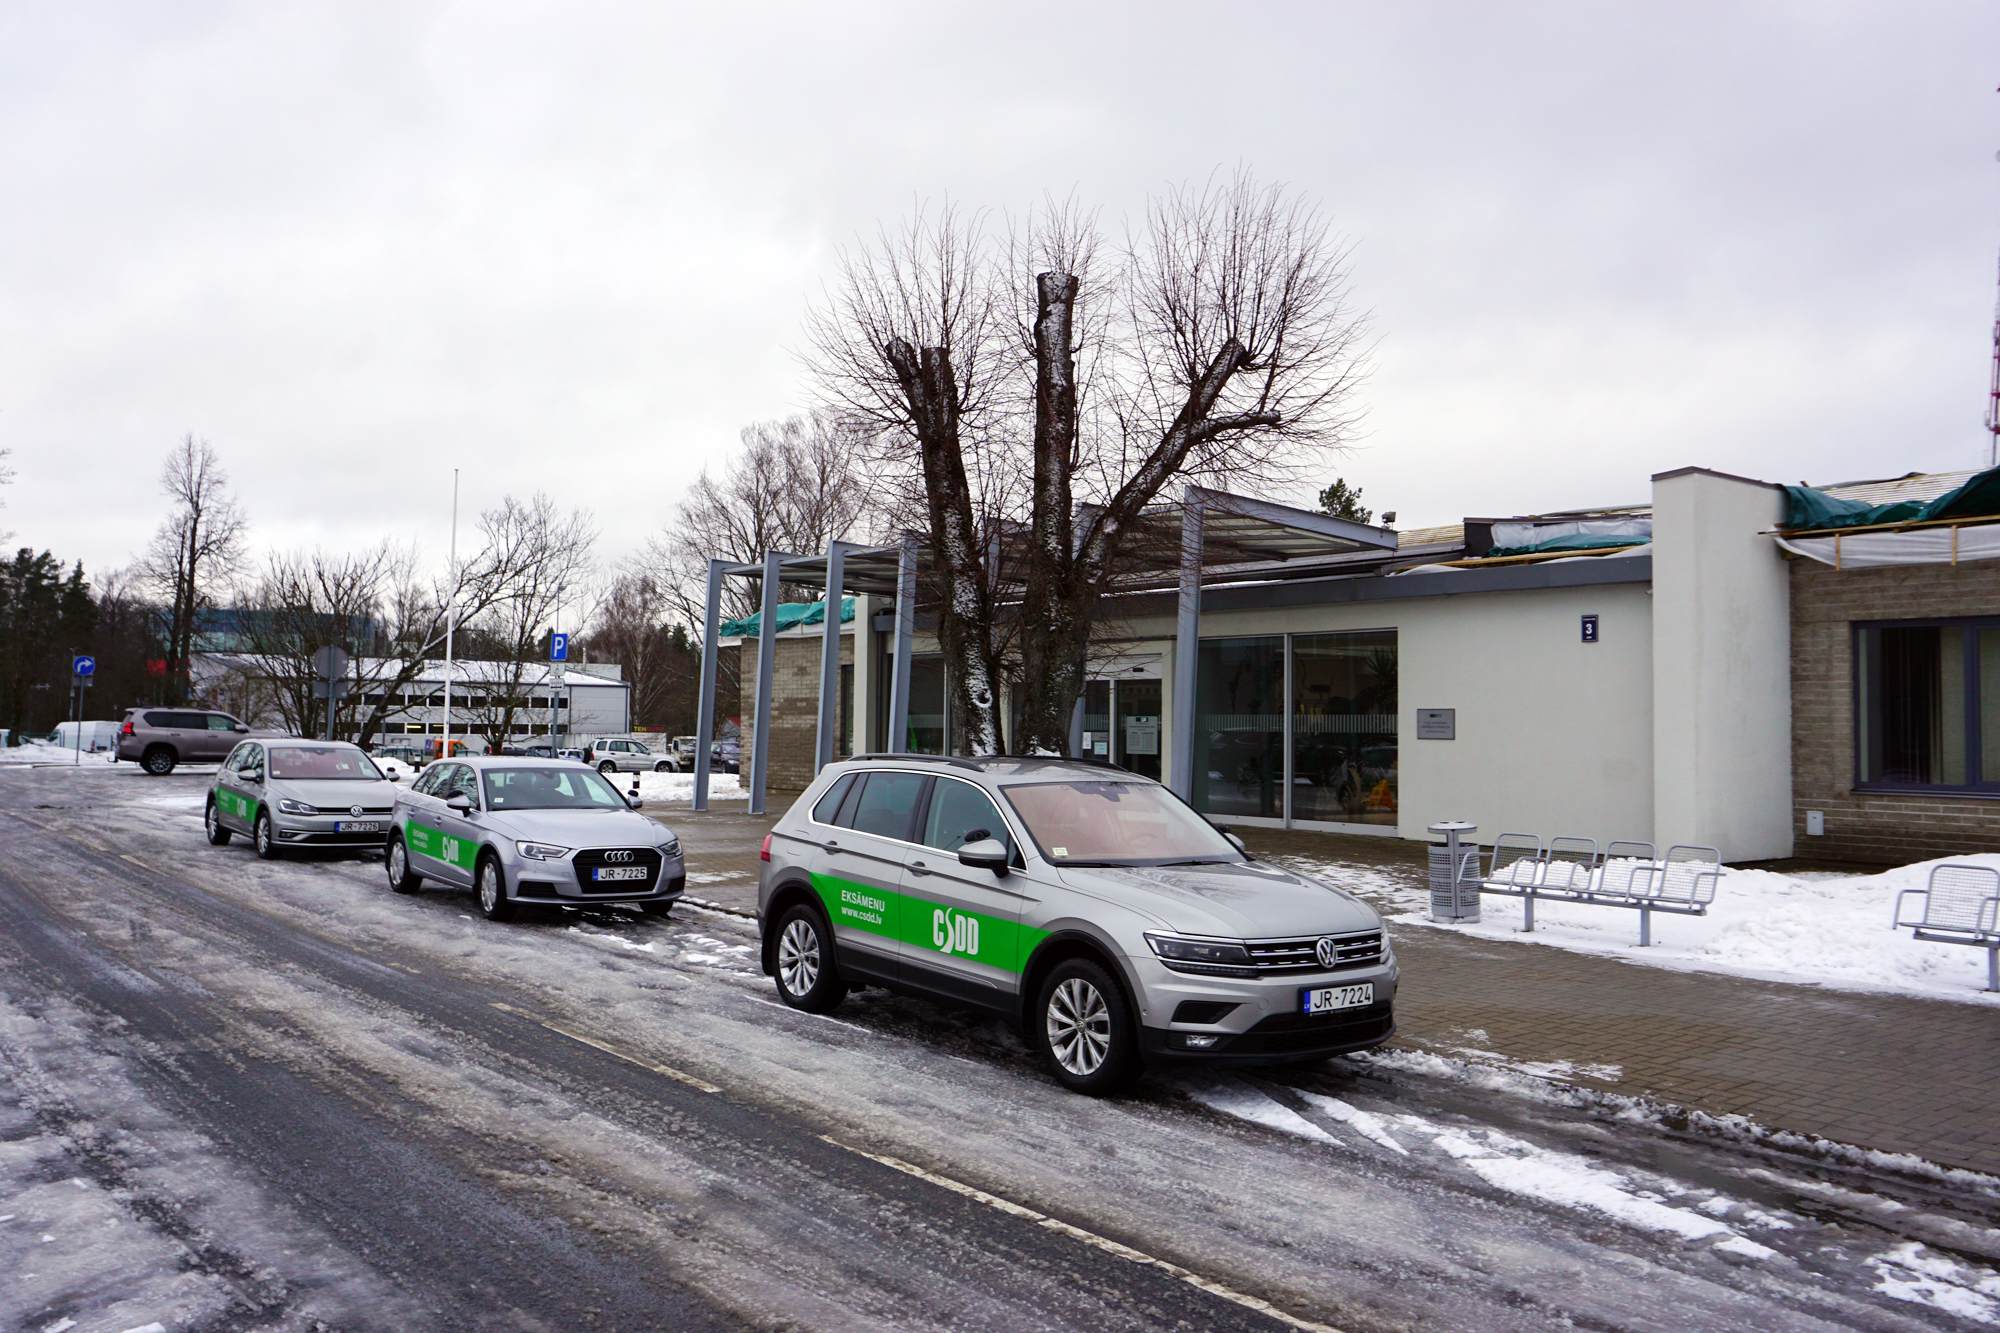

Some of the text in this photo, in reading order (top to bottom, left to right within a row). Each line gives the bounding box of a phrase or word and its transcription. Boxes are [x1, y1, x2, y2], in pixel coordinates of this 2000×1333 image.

[1585, 623, 1593, 635] 3
[553, 636, 565, 658] P
[341, 822, 378, 831] JR-7226
[600, 868, 646, 880] JR-7225
[841, 889, 885, 912] EKSĀMENU
[841, 905, 882, 925] www.csdd.lv
[933, 907, 979, 954] CSDD
[1313, 985, 1371, 1009] JR-7224
